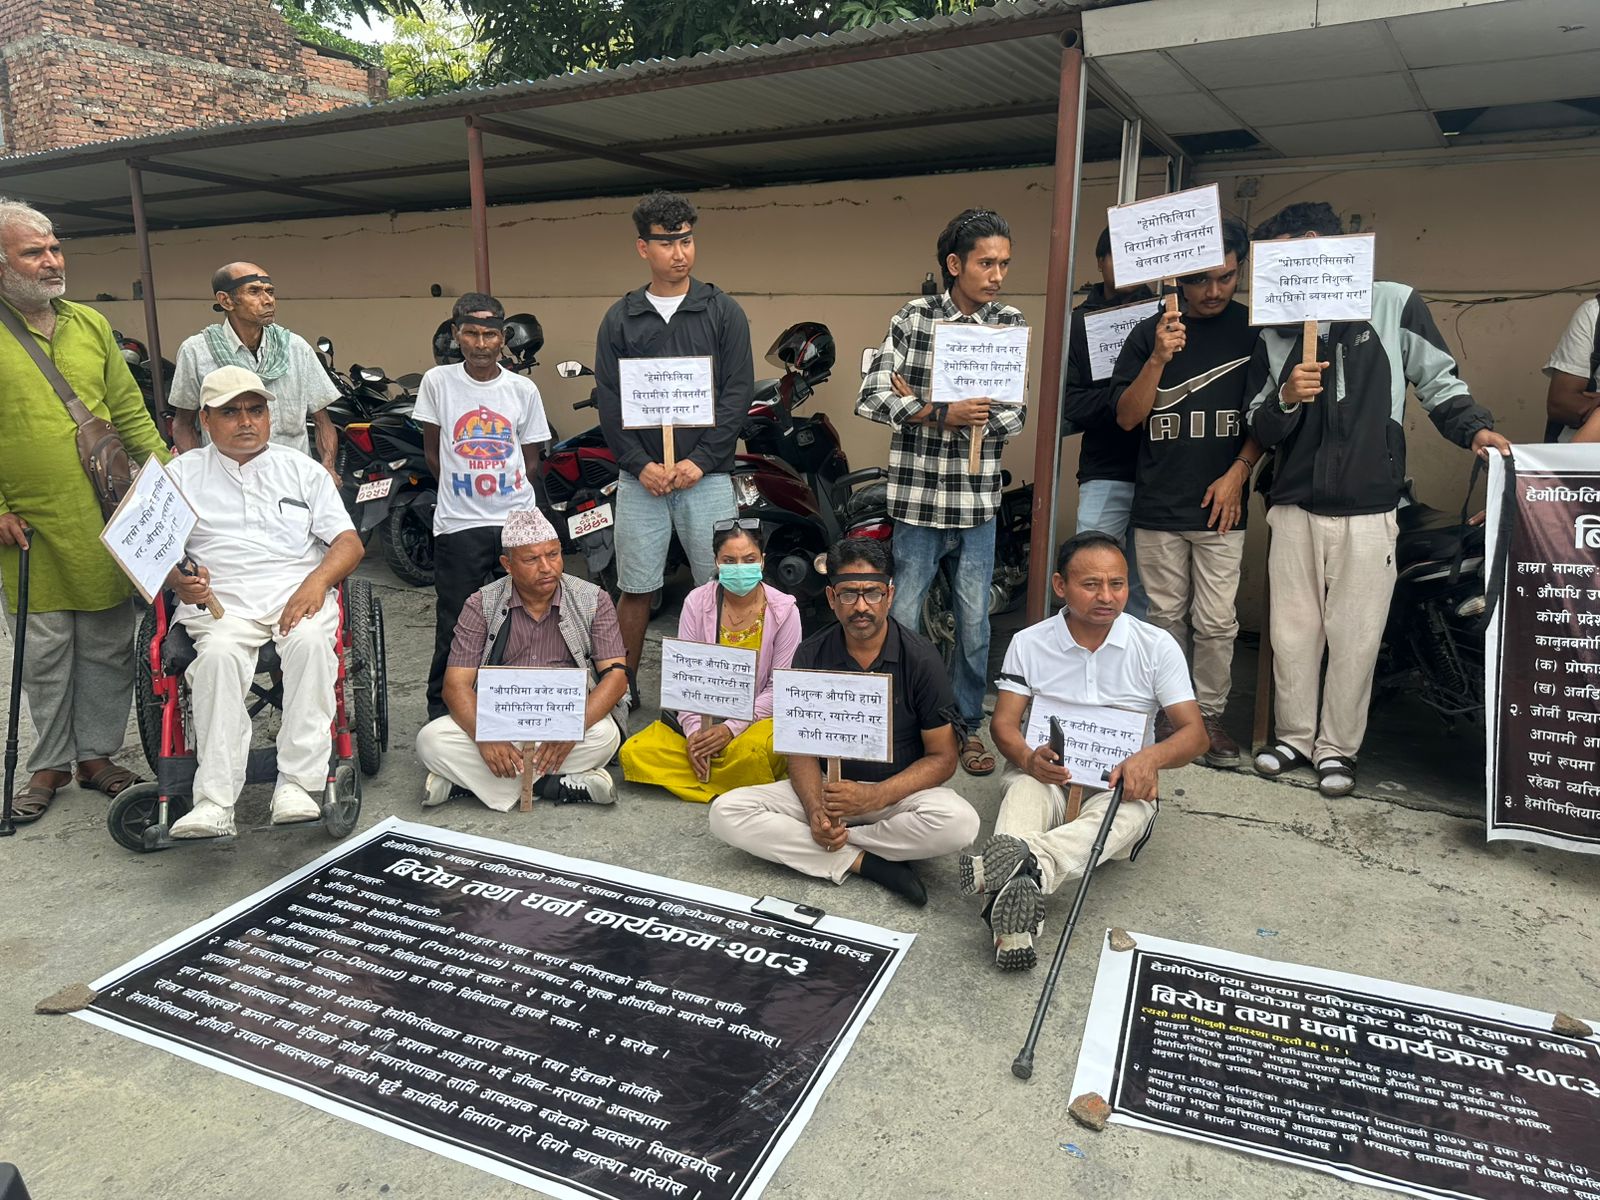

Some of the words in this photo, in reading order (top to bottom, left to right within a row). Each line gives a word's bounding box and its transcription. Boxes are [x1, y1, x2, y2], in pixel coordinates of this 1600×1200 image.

[1136, 208, 1196, 231] "हेमोफिलिया
[1123, 233, 1168, 253] बिरामीको
[1170, 224, 1214, 242] जीवनसँग
[1135, 253, 1171, 267] खेलवाड
[1172, 248, 1194, 259] नगर
[1150, 410, 1240, 441] AIR
[469, 460, 507, 470] HAPPY
[452, 468, 522, 497] HOLI
[1516, 561, 1547, 574] हाम्रा
[1516, 585, 1528, 596] १.
[1536, 582, 1581, 599] औषधि
[1535, 608, 1571, 624] कोशी
[1534, 657, 1557, 672] (क)
[1564, 659, 1600, 674] प्रोफा
[785, 685, 823, 702] "निशुल्क
[858, 691, 882, 705] हाम्रो
[1533, 681, 1555, 696] (ख)
[785, 705, 826, 721] अधिकार,
[828, 709, 865, 723] ग्यारेन्टी
[867, 714, 883, 725] गर
[1509, 703, 1521, 716] २.
[1529, 703, 1560, 718] जोर्नी
[1566, 710, 1600, 723] प्रत्या
[797, 726, 822, 740] कोशी
[824, 731, 857, 743] सरकार
[1529, 728, 1577, 744] आगामी
[1528, 751, 1552, 765] पूर्ण
[1557, 756, 1595, 771] रूपमा
[1526, 773, 1560, 789] रहेका
[1504, 795, 1516, 807] ३.
[381, 839, 446, 858] हेमोफिलिया
[444, 854, 480, 867] भएका
[544, 875, 581, 889] जीवन
[581, 884, 624, 899] रक्षाका
[623, 895, 658, 908] लागि
[724, 918, 750, 931] हुने
[750, 924, 785, 938] बजेट
[785, 933, 832, 951] कटौती
[382, 857, 465, 889] बिरोध
[460, 879, 523, 902] तथा
[520, 892, 588, 917] धर्ना
[583, 907, 808, 976] कार्यक्रम-२०८३
[244, 926, 267, 938] (ख)
[265, 933, 320, 953] अनडिमान्ड
[408, 974, 427, 984] का
[426, 979, 457, 993] लागि
[509, 1003, 548, 1019] हुनुपर्ने
[619, 1036, 659, 1055] करोड
[200, 952, 240, 967] आगामी
[237, 963, 276, 979] आर्थिक
[274, 974, 307, 989] वर्षमा
[304, 984, 337, 999] कोशी
[381, 1005, 462, 1039] हेमोफिलियाका
[461, 1033, 501, 1051] कारण
[501, 1044, 541, 1065] कम्मर
[541, 1057, 569, 1073] तथा
